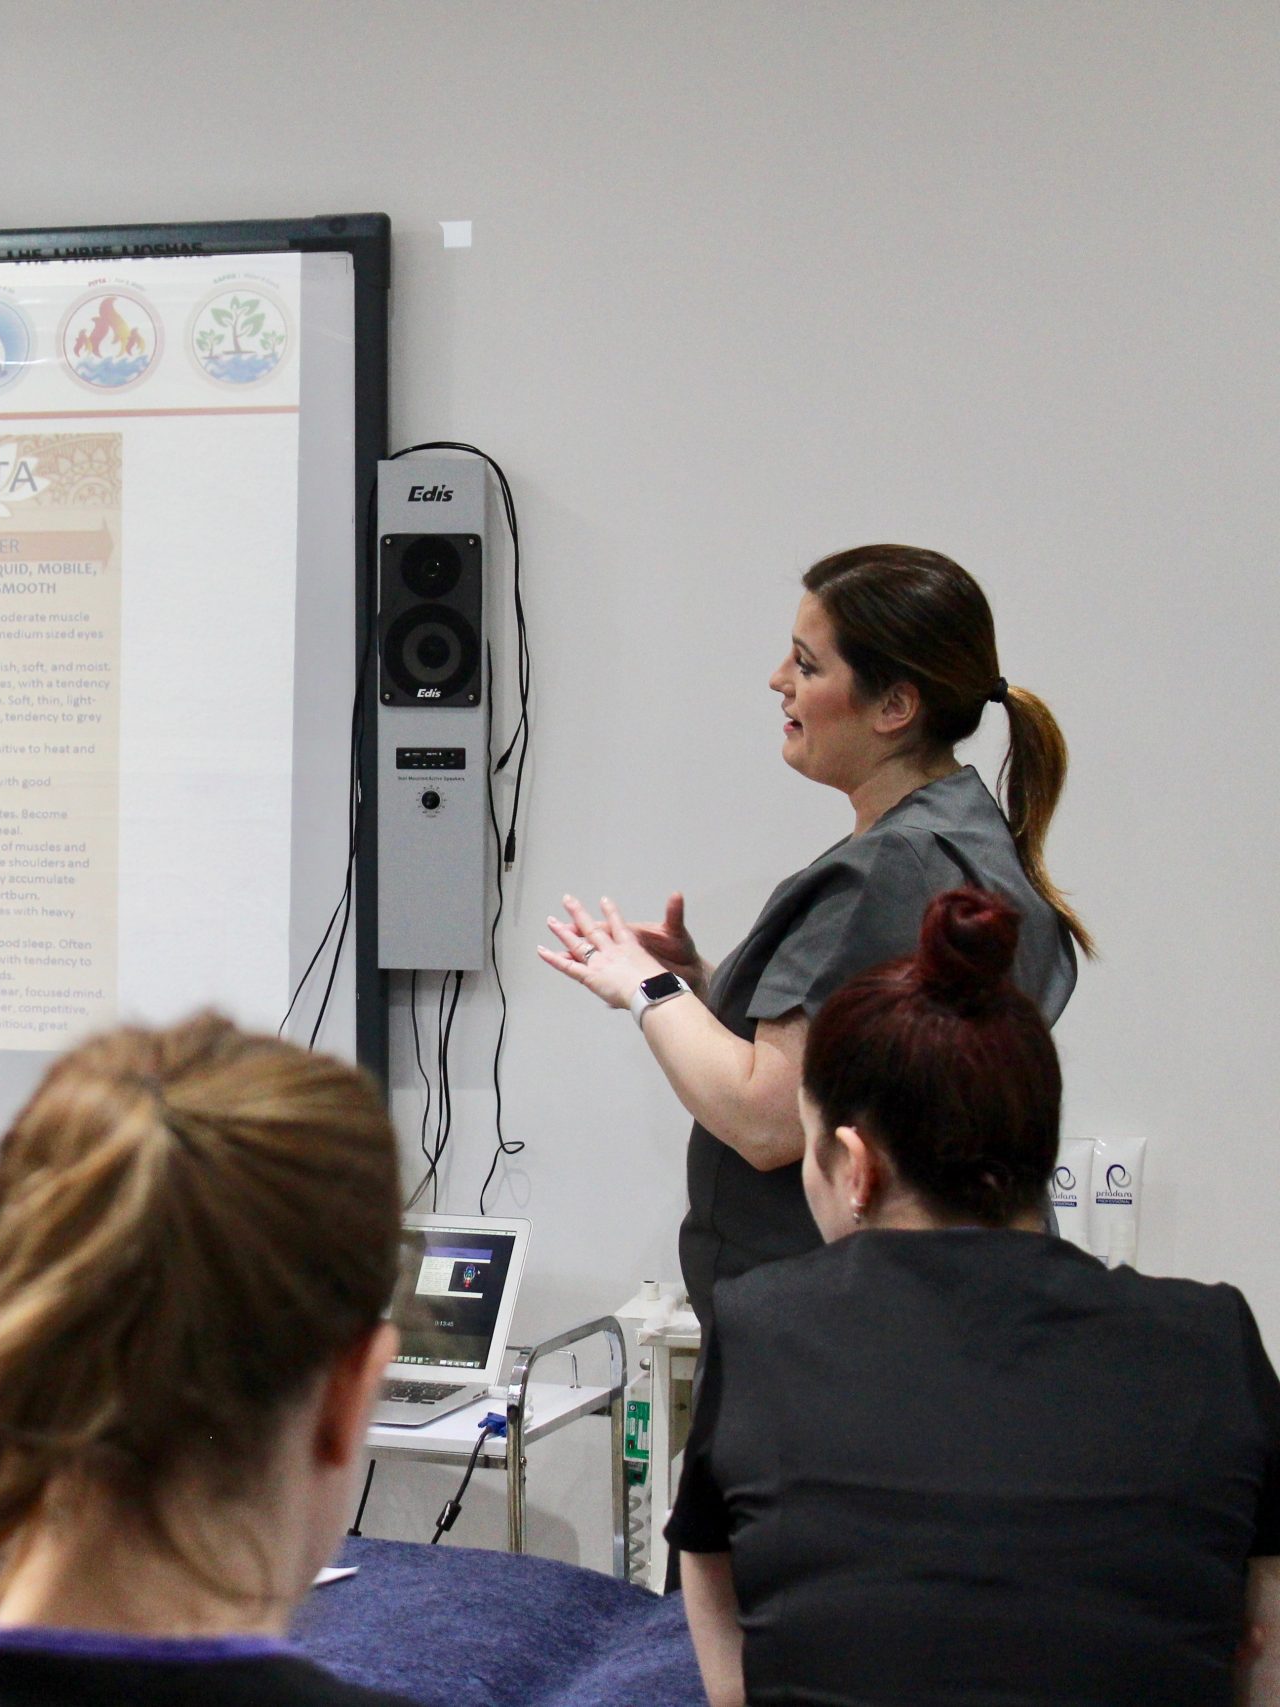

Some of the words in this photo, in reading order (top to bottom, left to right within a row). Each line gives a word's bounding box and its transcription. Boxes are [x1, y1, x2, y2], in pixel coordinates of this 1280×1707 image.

[408, 485, 454, 502] Edis
[38, 564, 97, 576] MOBILE,
[49, 612, 89, 622] muscle
[417, 687, 441, 699] Edis
[22, 777, 51, 788] good
[2, 842, 13, 851] of
[15, 842, 61, 852] muscles
[64, 843, 86, 852] and
[9, 875, 75, 884] accumulate
